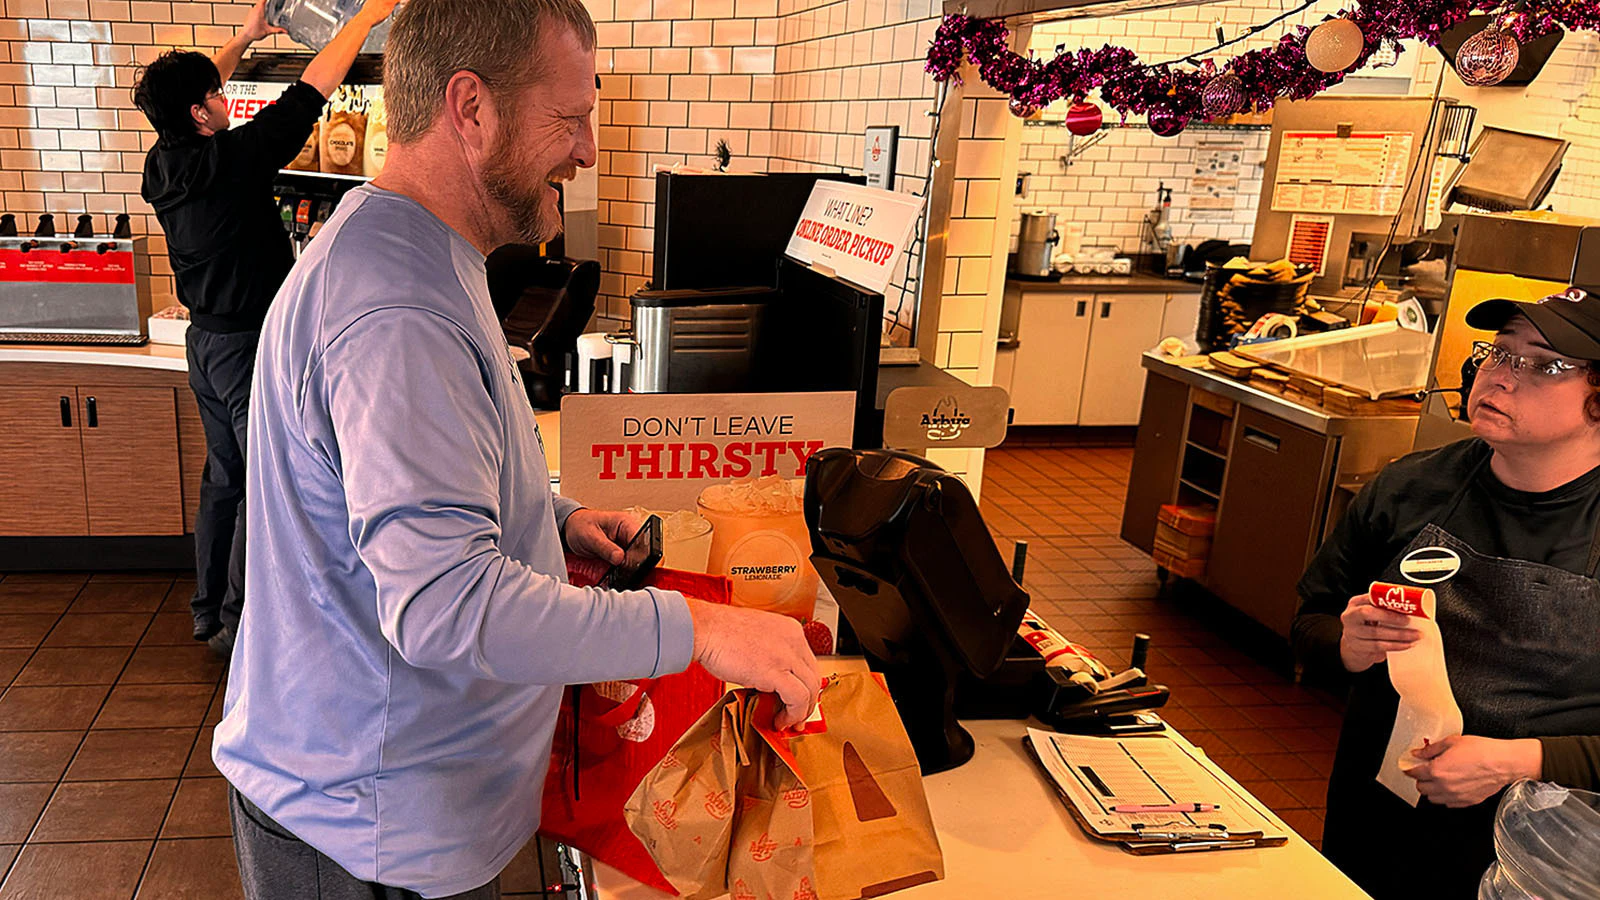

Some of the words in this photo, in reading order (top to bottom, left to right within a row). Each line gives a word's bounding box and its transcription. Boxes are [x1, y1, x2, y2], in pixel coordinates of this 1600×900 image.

[225, 84, 238, 95] OR
[240, 84, 258, 95] THE
[223, 98, 277, 119] WEET
[823, 199, 850, 220] WHAT
[845, 202, 874, 227] LINE?
[795, 218, 825, 243] ONLINE
[819, 224, 853, 253] ORDER
[847, 233, 895, 266] PICKUP
[624, 417, 706, 436] DON'T
[713, 416, 794, 436] LEAVE
[591, 440, 825, 480] THIRSTY
[731, 565, 797, 575] STRAWBERRY
[1378, 597, 1417, 613] Arby's
